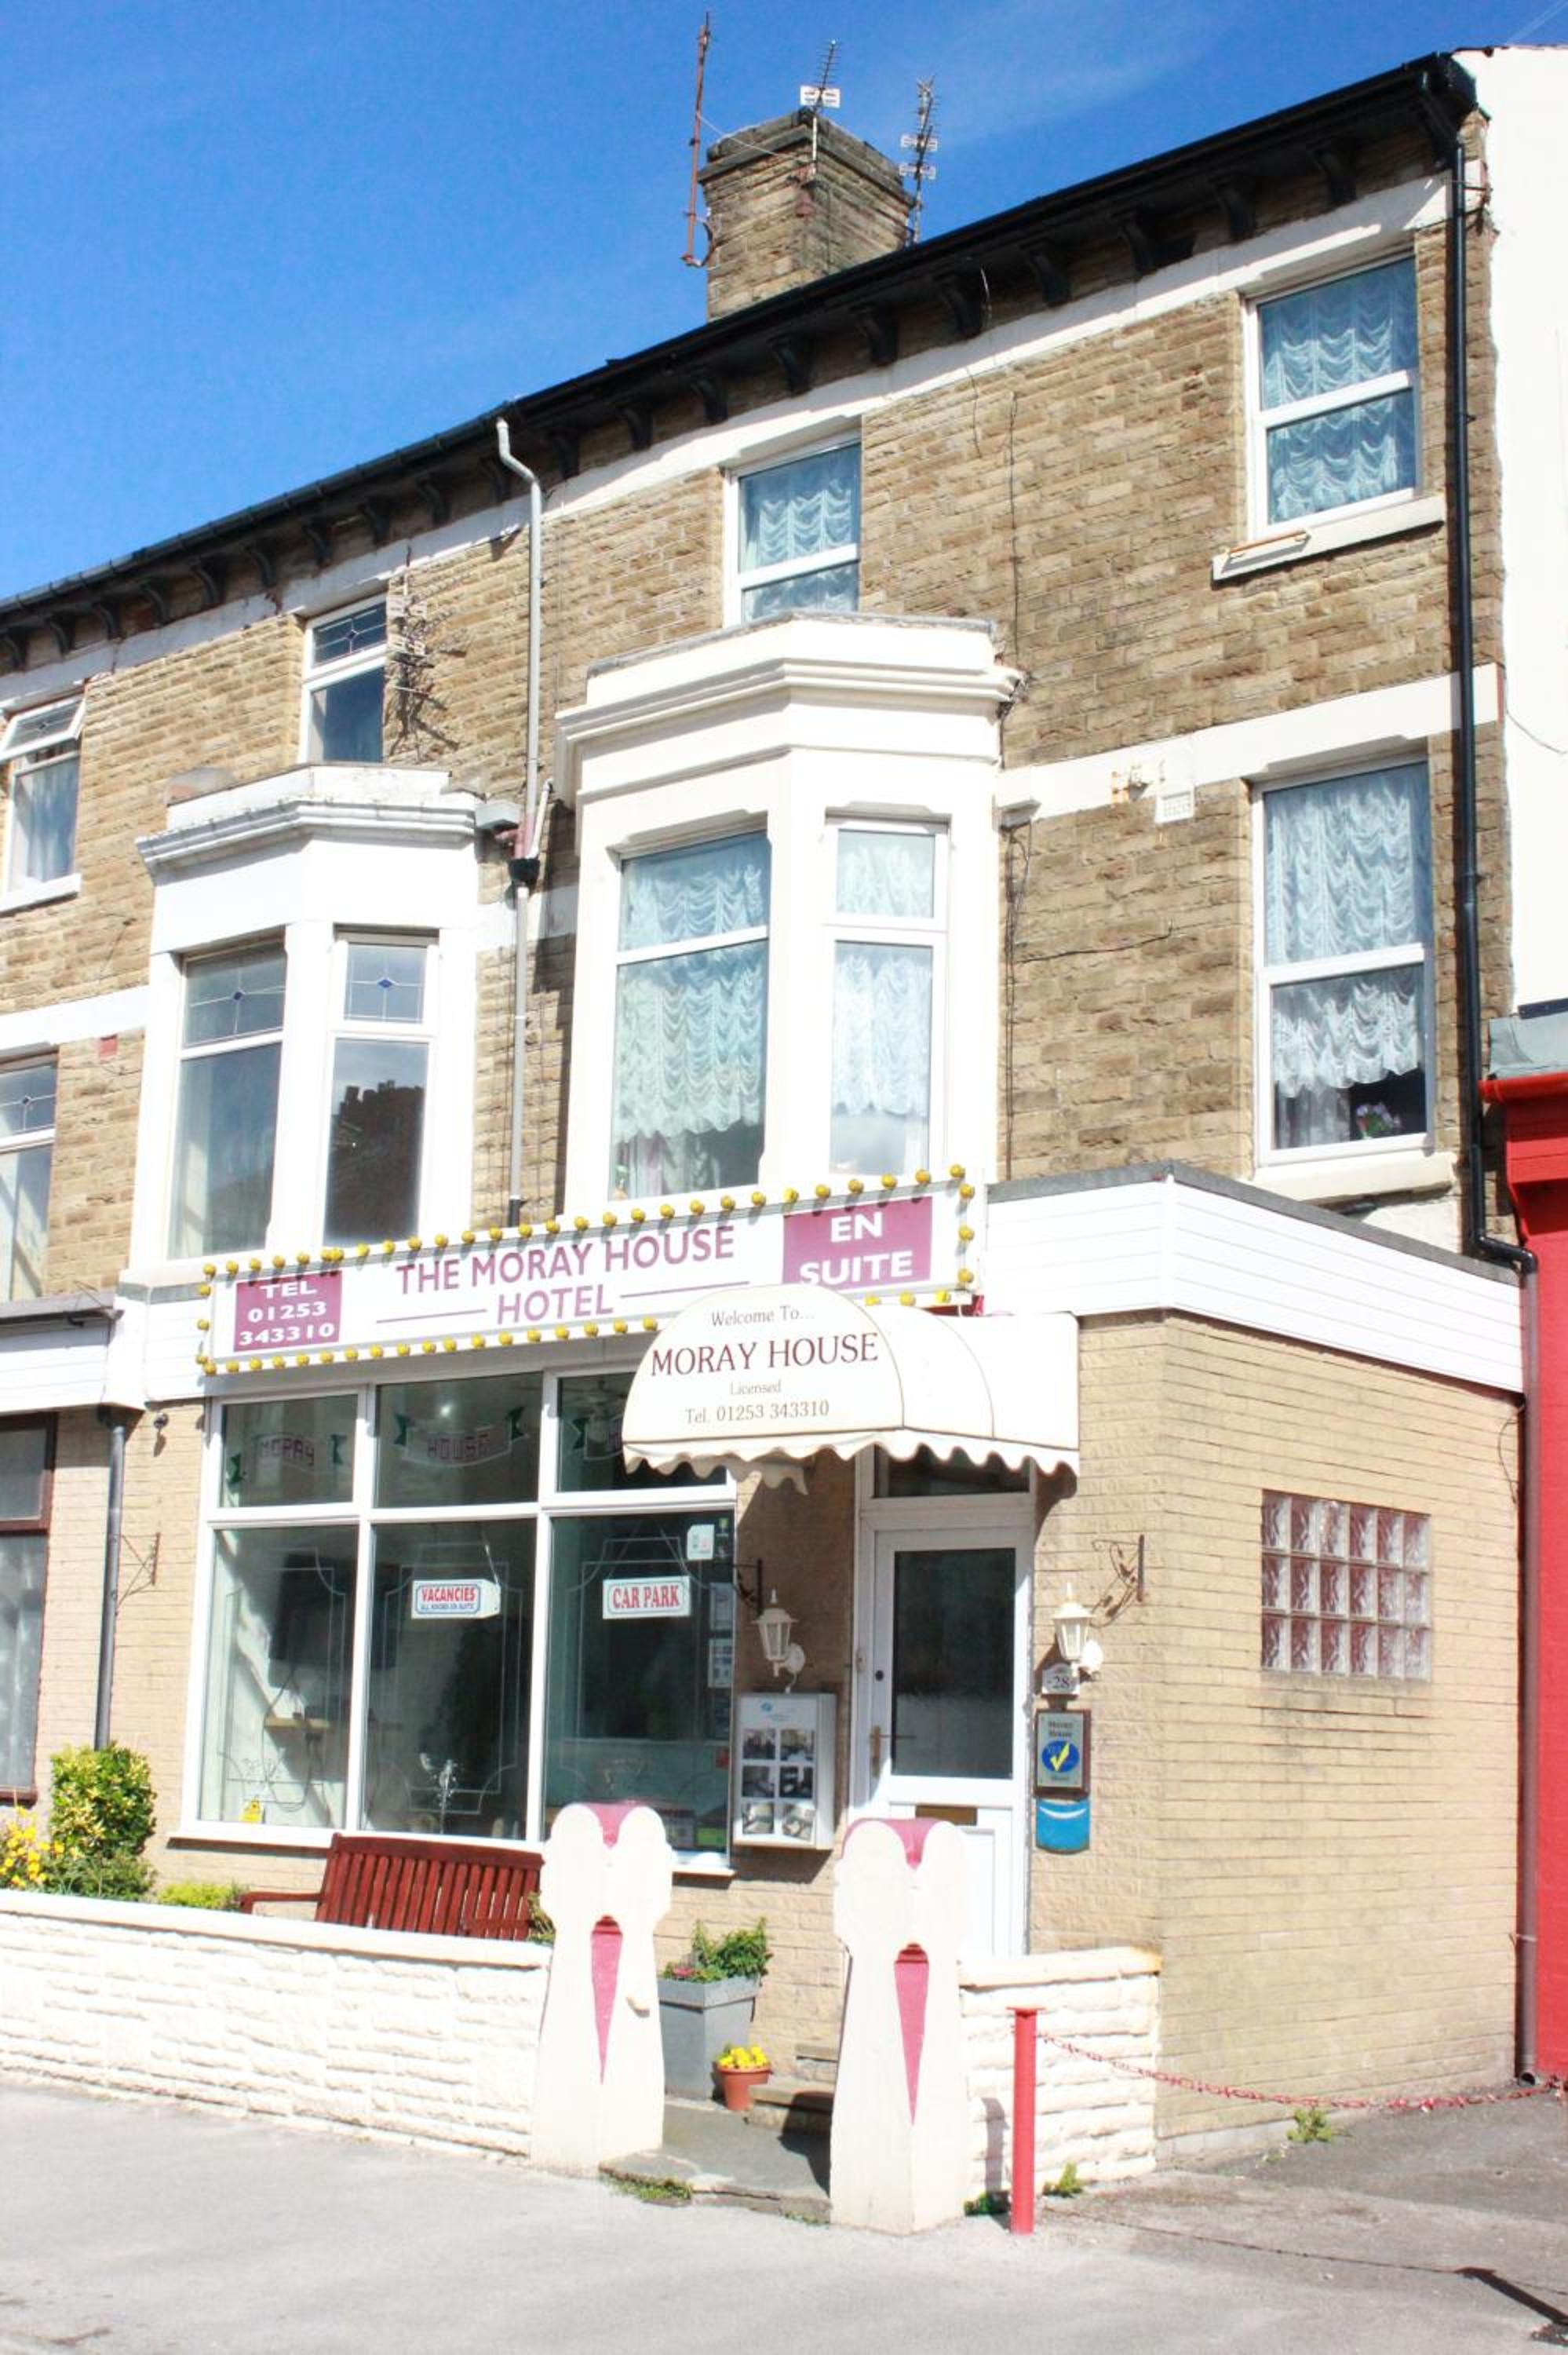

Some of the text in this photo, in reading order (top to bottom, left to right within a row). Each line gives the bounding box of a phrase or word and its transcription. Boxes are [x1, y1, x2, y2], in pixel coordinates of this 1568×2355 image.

[830, 1211, 883, 1243] EN
[396, 1225, 735, 1294] THE MORAY HOUSE
[800, 1251, 913, 1285] SUITE
[260, 1280, 317, 1298] TEL
[247, 1301, 326, 1323] 01253
[497, 1284, 614, 1324] HOTEL
[711, 1310, 775, 1327] Welcome
[239, 1323, 335, 1345] 343310
[651, 1332, 879, 1377] MORAY HOUSE
[729, 1379, 782, 1396] Licensed
[717, 1404, 764, 1422] 01253
[770, 1400, 830, 1420] 343310
[421, 1586, 476, 1602] VACANCIES
[613, 1584, 680, 1608] CAR PARK
